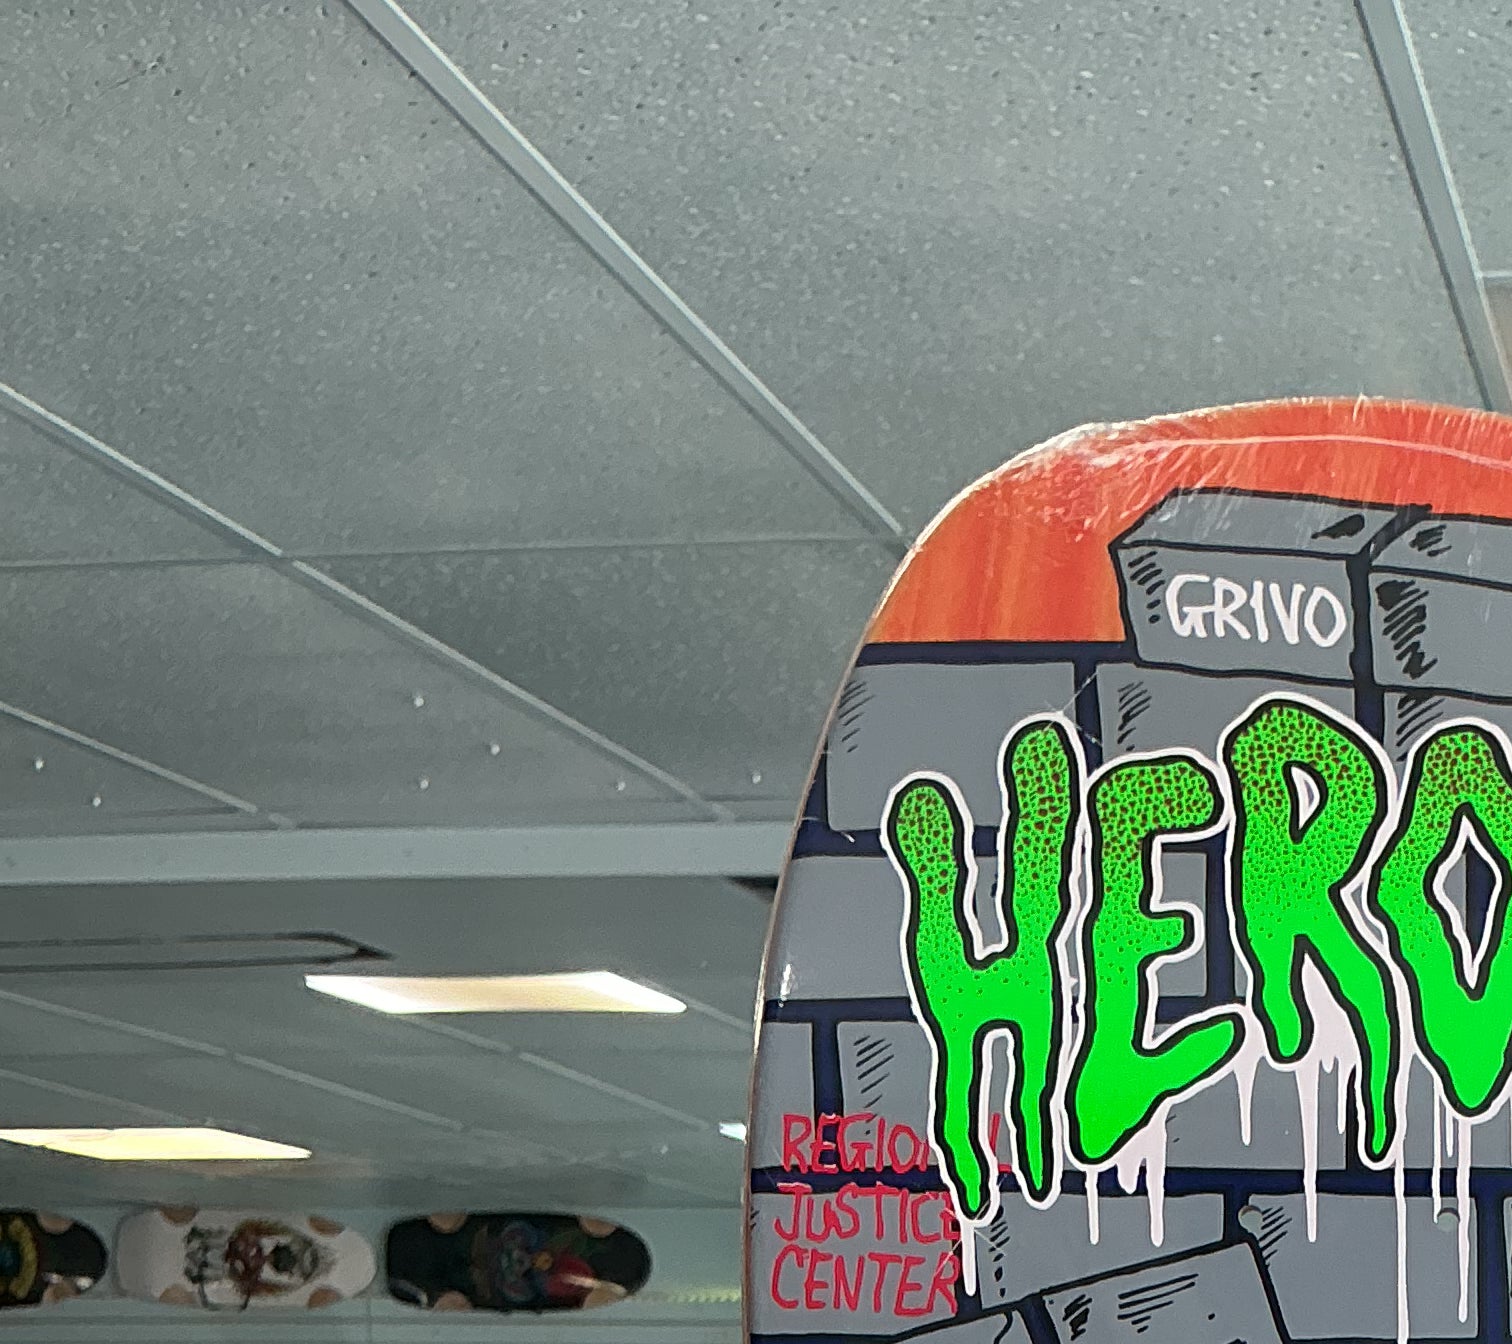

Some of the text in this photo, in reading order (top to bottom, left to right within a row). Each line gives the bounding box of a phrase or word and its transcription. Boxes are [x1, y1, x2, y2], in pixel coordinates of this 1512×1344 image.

[1166, 574, 1347, 647] GRIVO
[782, 1112, 1013, 1175] REGIOL
[771, 1246, 960, 1317] CENTER
